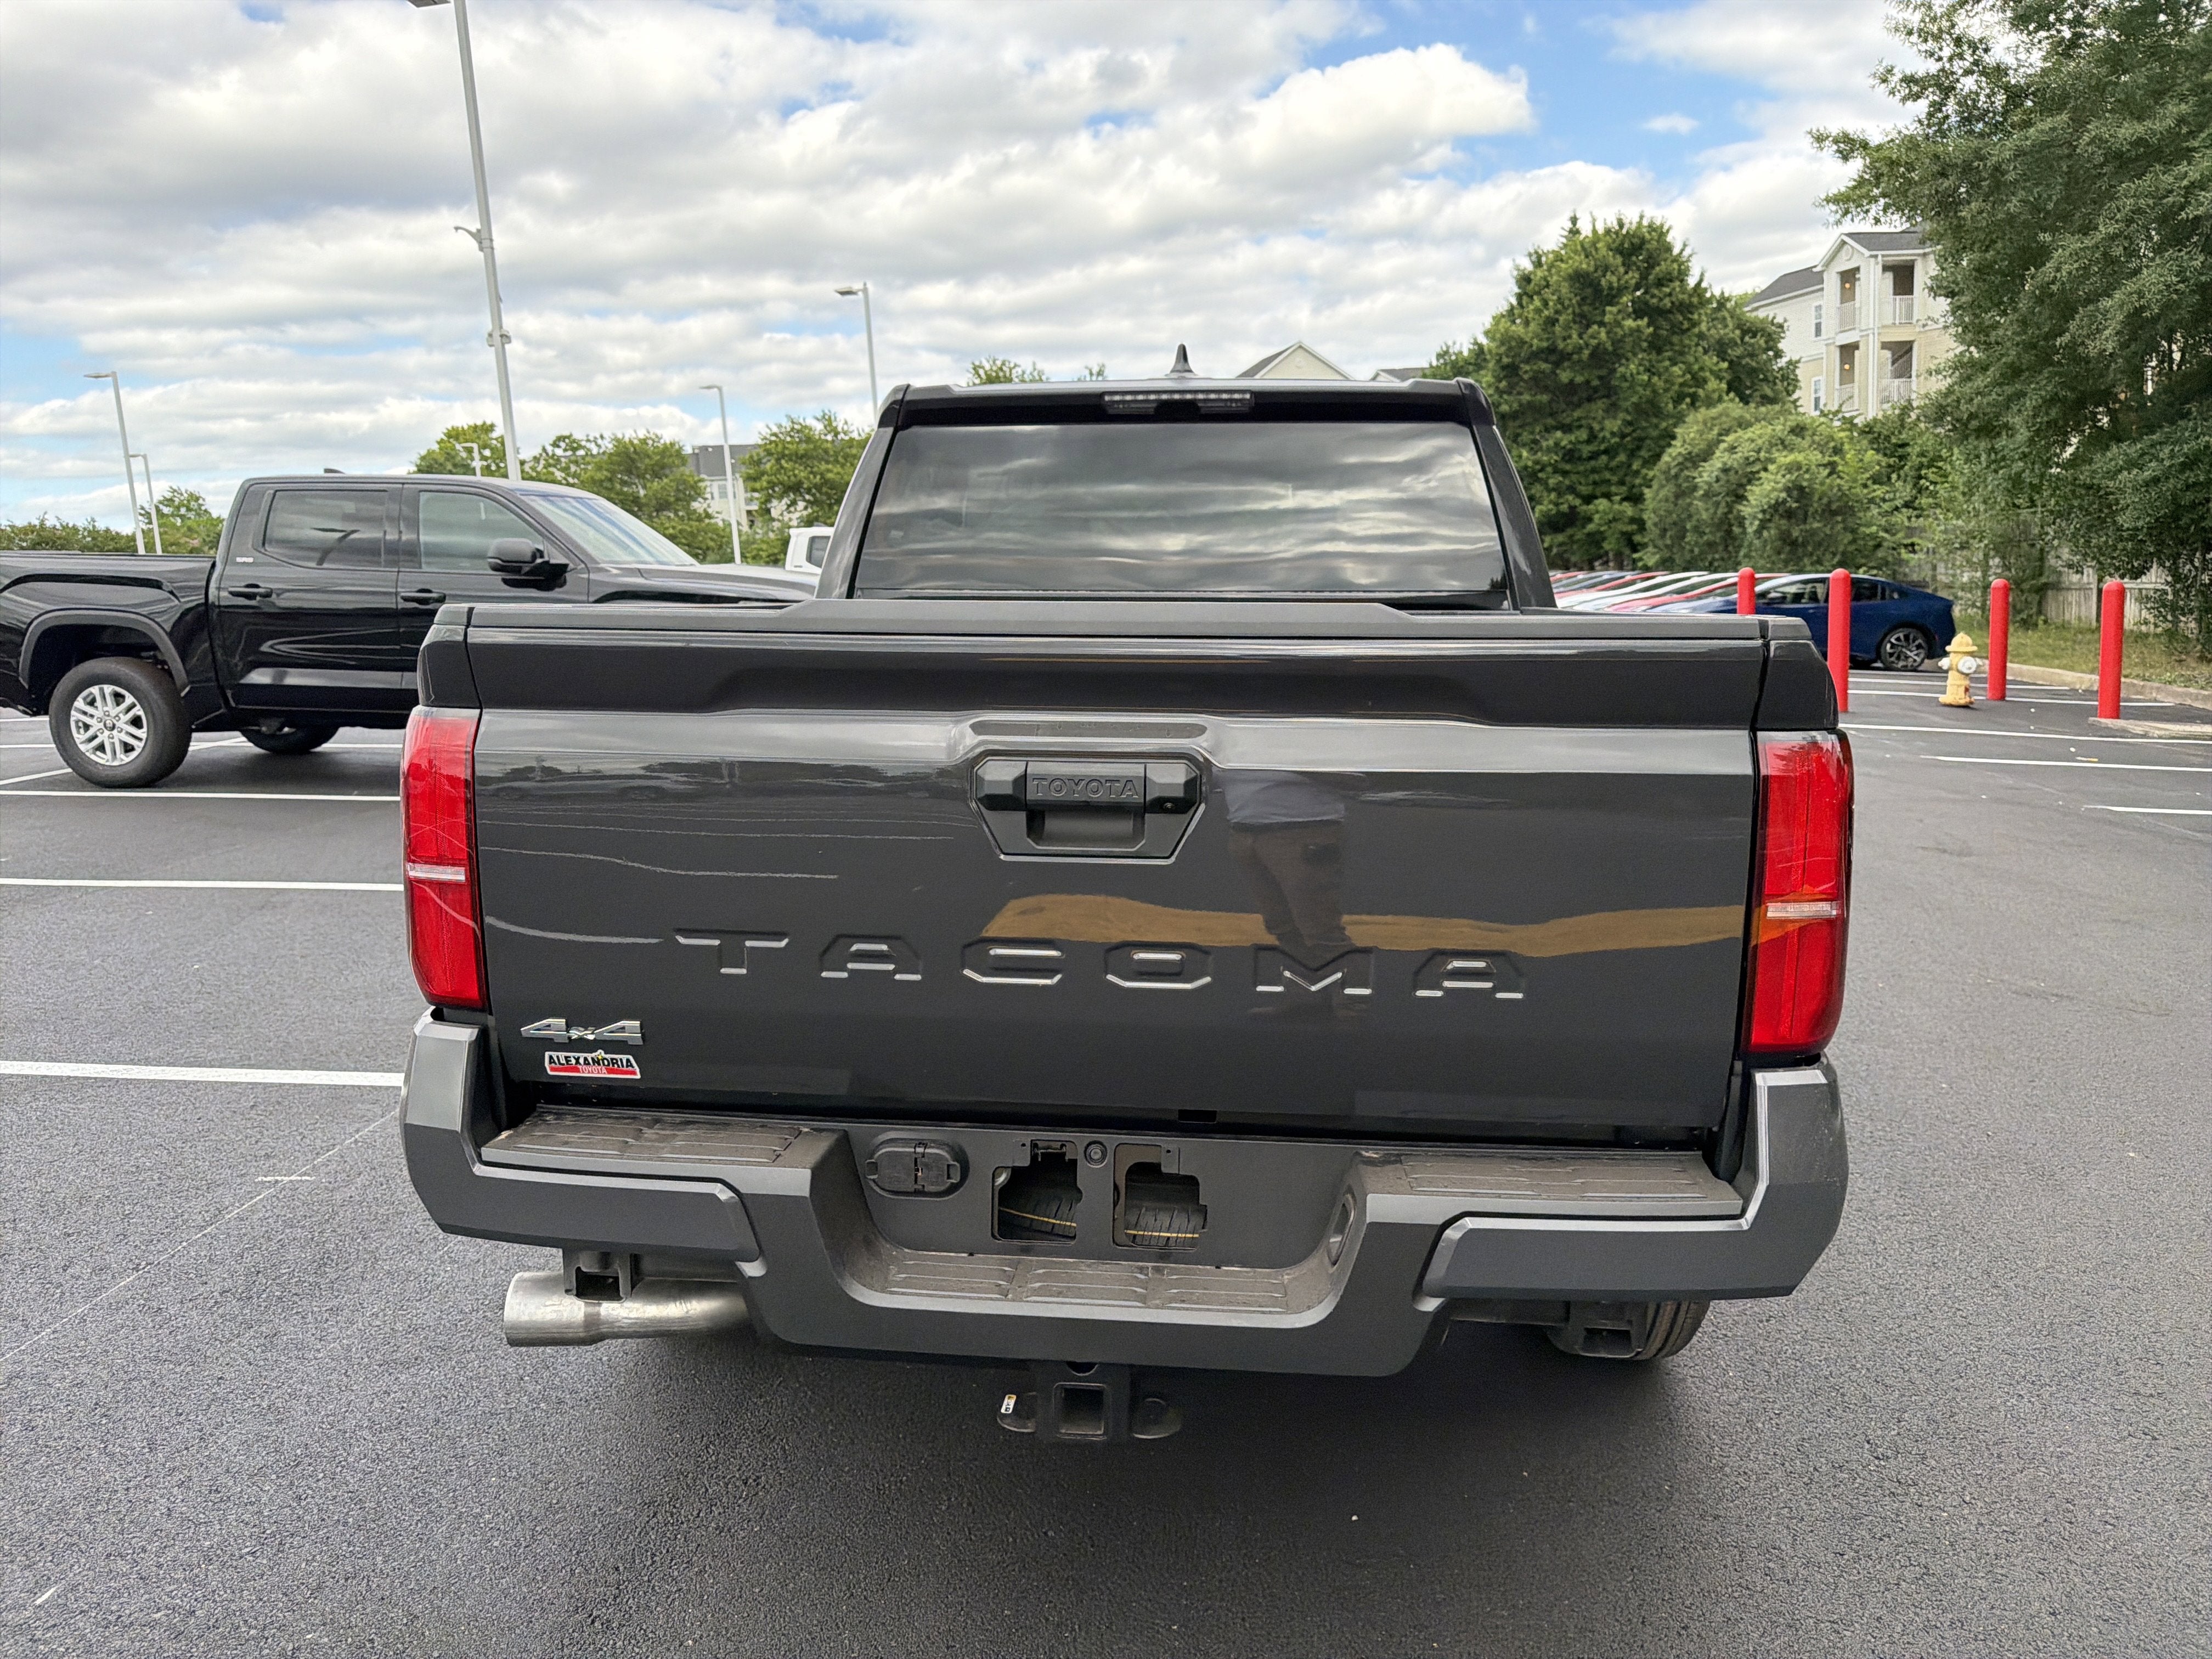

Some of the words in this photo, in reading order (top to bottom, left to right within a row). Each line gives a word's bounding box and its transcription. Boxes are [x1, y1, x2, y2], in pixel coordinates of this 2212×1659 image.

[1032, 777, 1139, 798] TOYOTA
[674, 927, 1526, 1000] TACOMA
[549, 1054, 635, 1069] ALEXANDRIA
[579, 1065, 607, 1075] TOYOTA
